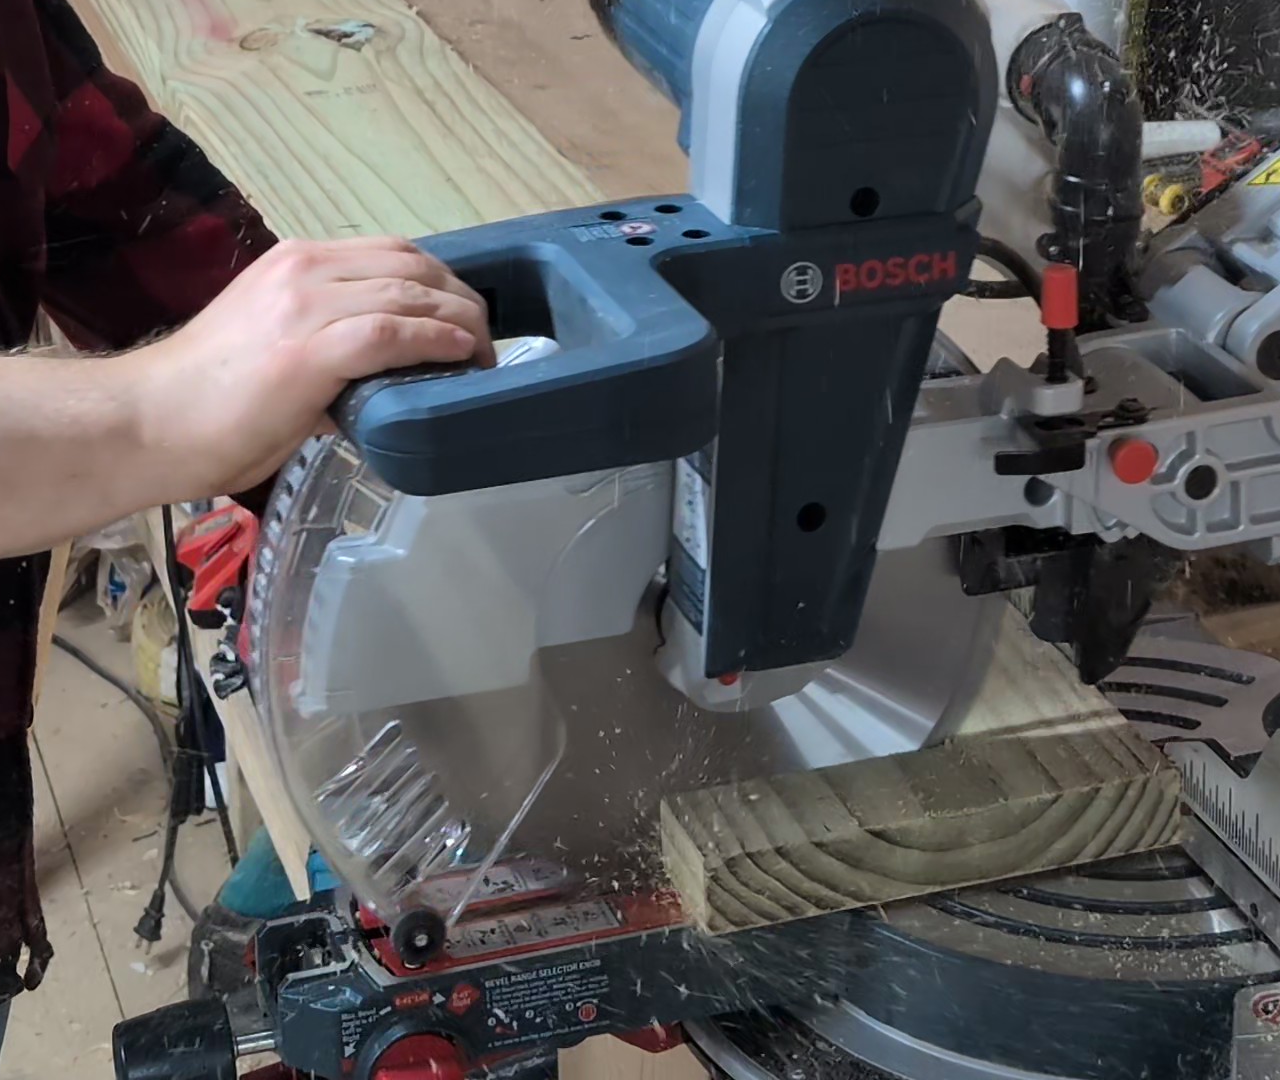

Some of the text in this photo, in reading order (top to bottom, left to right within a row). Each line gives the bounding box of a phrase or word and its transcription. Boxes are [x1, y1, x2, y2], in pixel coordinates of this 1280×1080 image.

[835, 251, 958, 291] BOSCH
[485, 976, 509, 988] BEVEL
[510, 971, 537, 983] RANGE
[539, 963, 577, 977] SELECTOR
